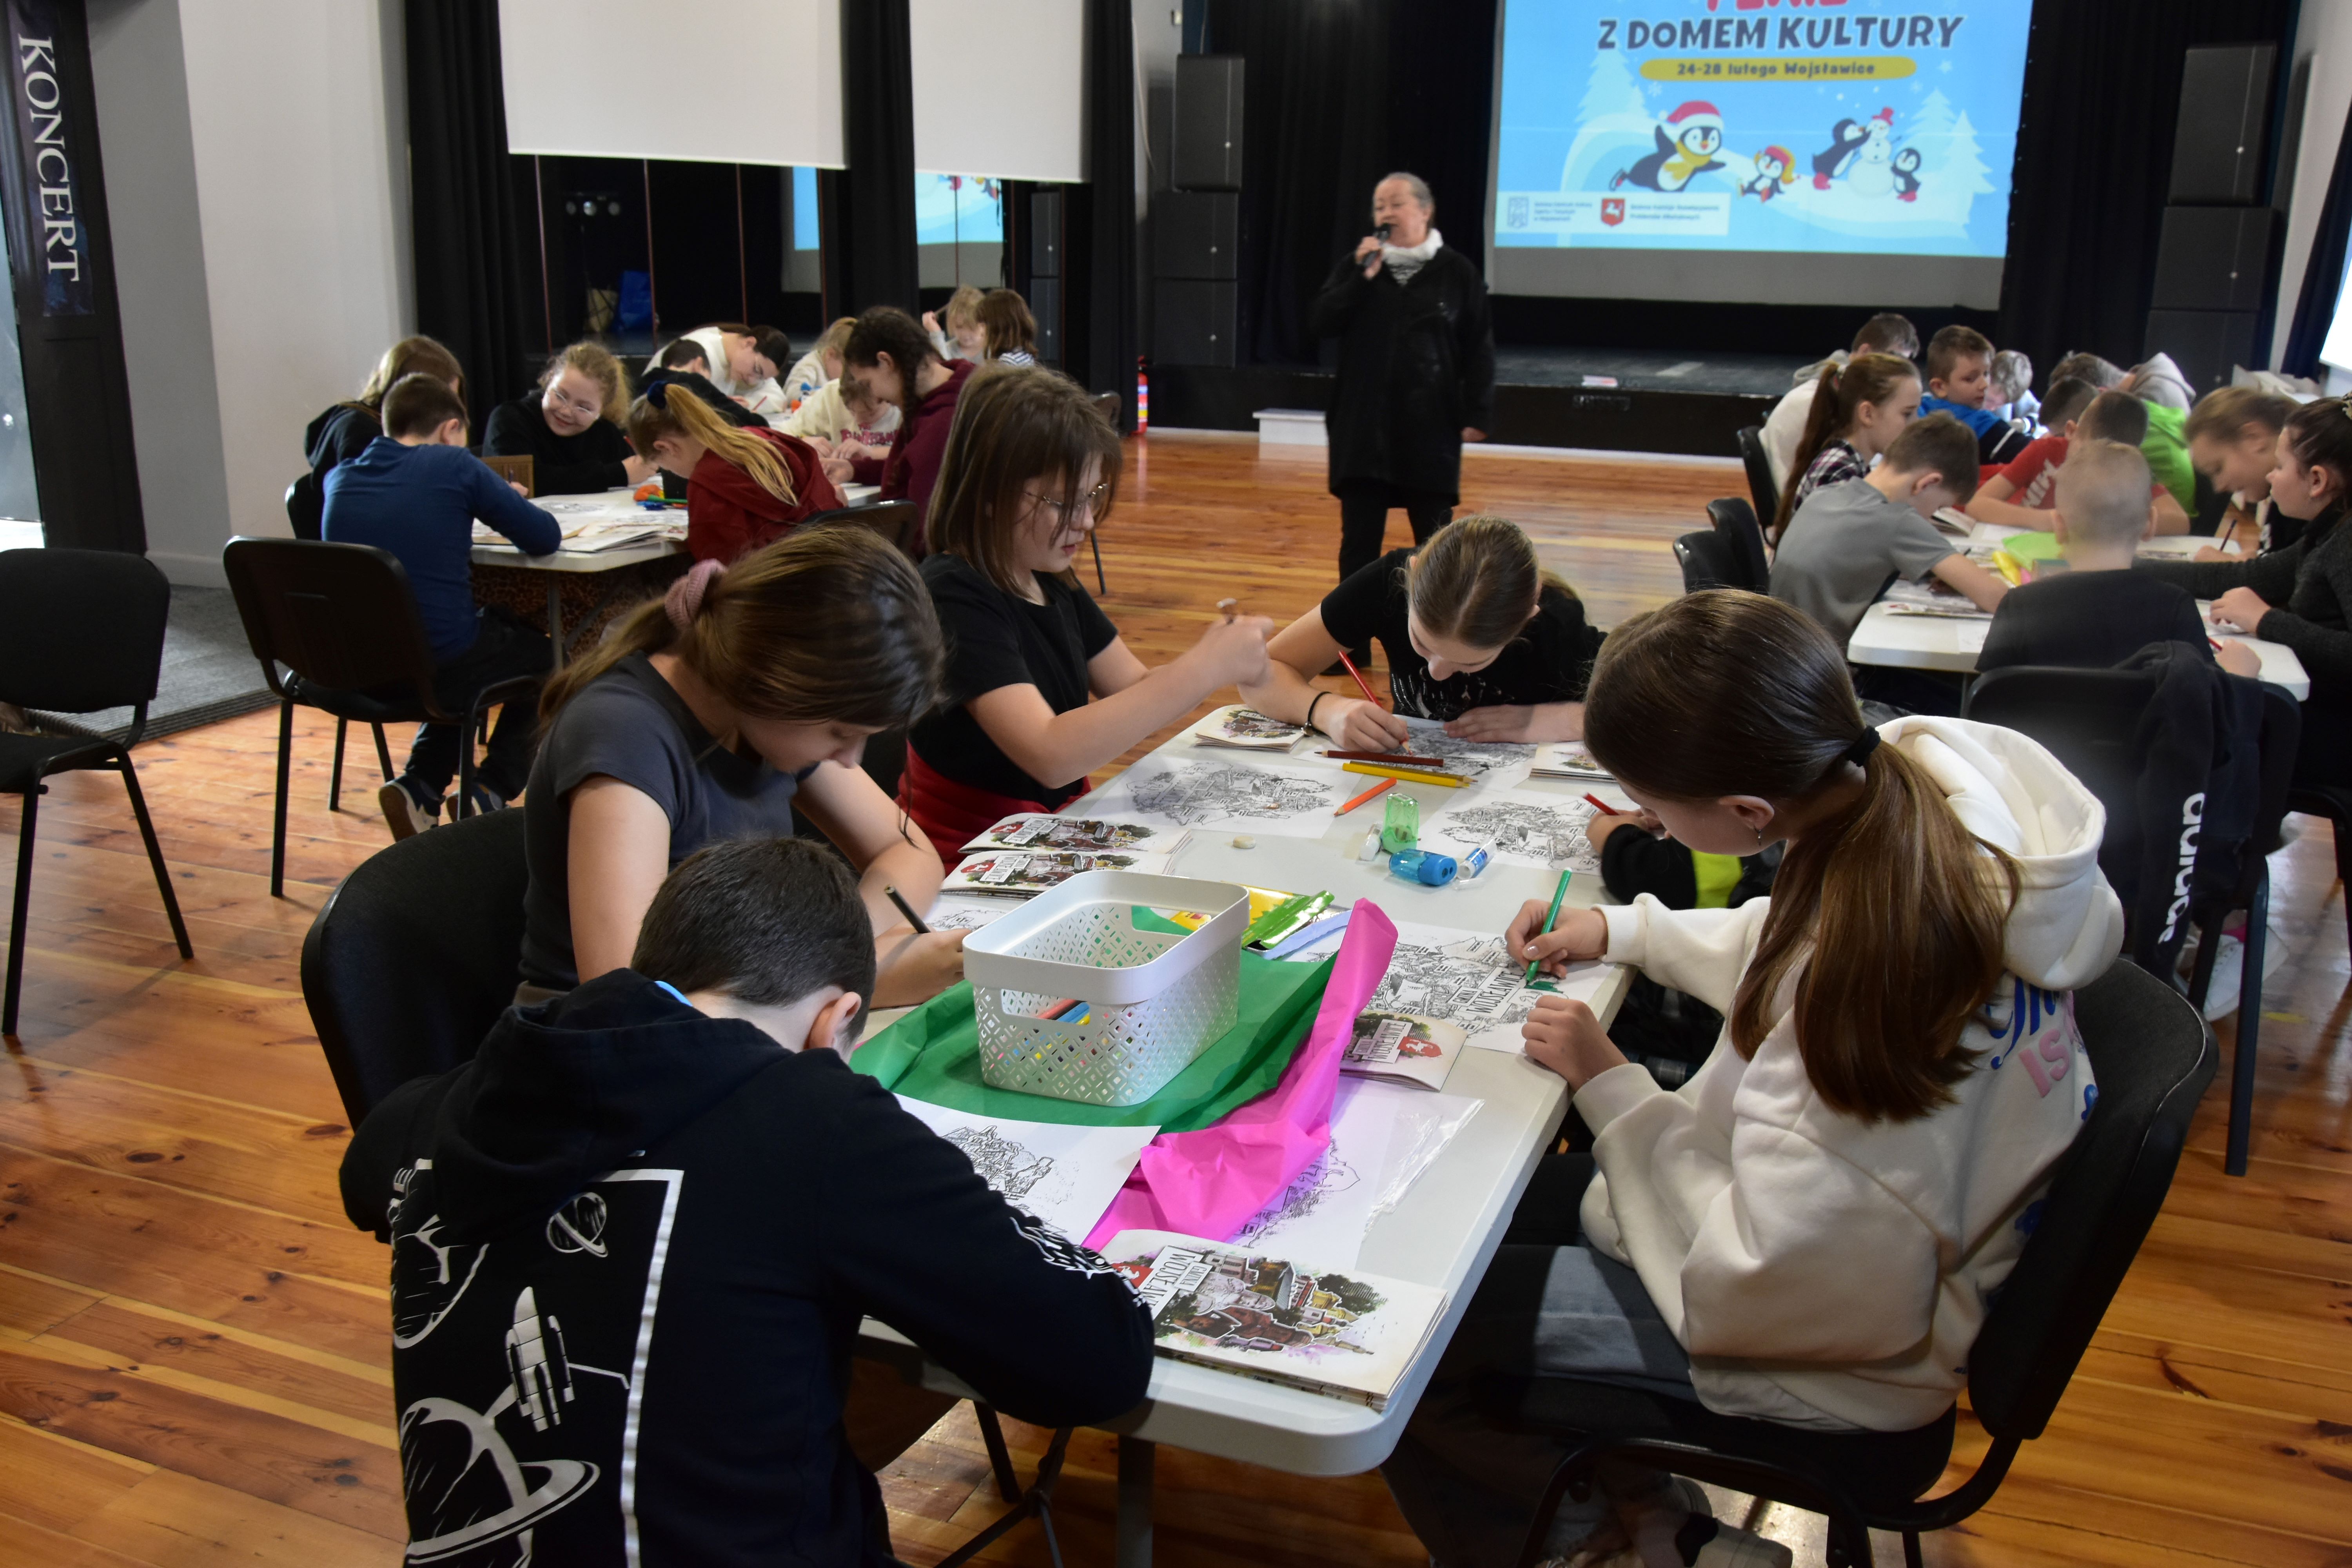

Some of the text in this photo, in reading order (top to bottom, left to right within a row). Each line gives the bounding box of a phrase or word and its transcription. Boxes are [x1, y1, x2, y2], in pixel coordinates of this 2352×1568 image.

[1598, 15, 1964, 50] Z DOMEM KULTURY
[1678, 63, 1721, 76] 24-28
[1728, 63, 1777, 78] lutego
[18, 33, 80, 282] KONCERT
[2020, 458, 2057, 507] NIK
[1452, 989, 1478, 1004] GMINA
[1179, 1265, 1207, 1286] GMINA
